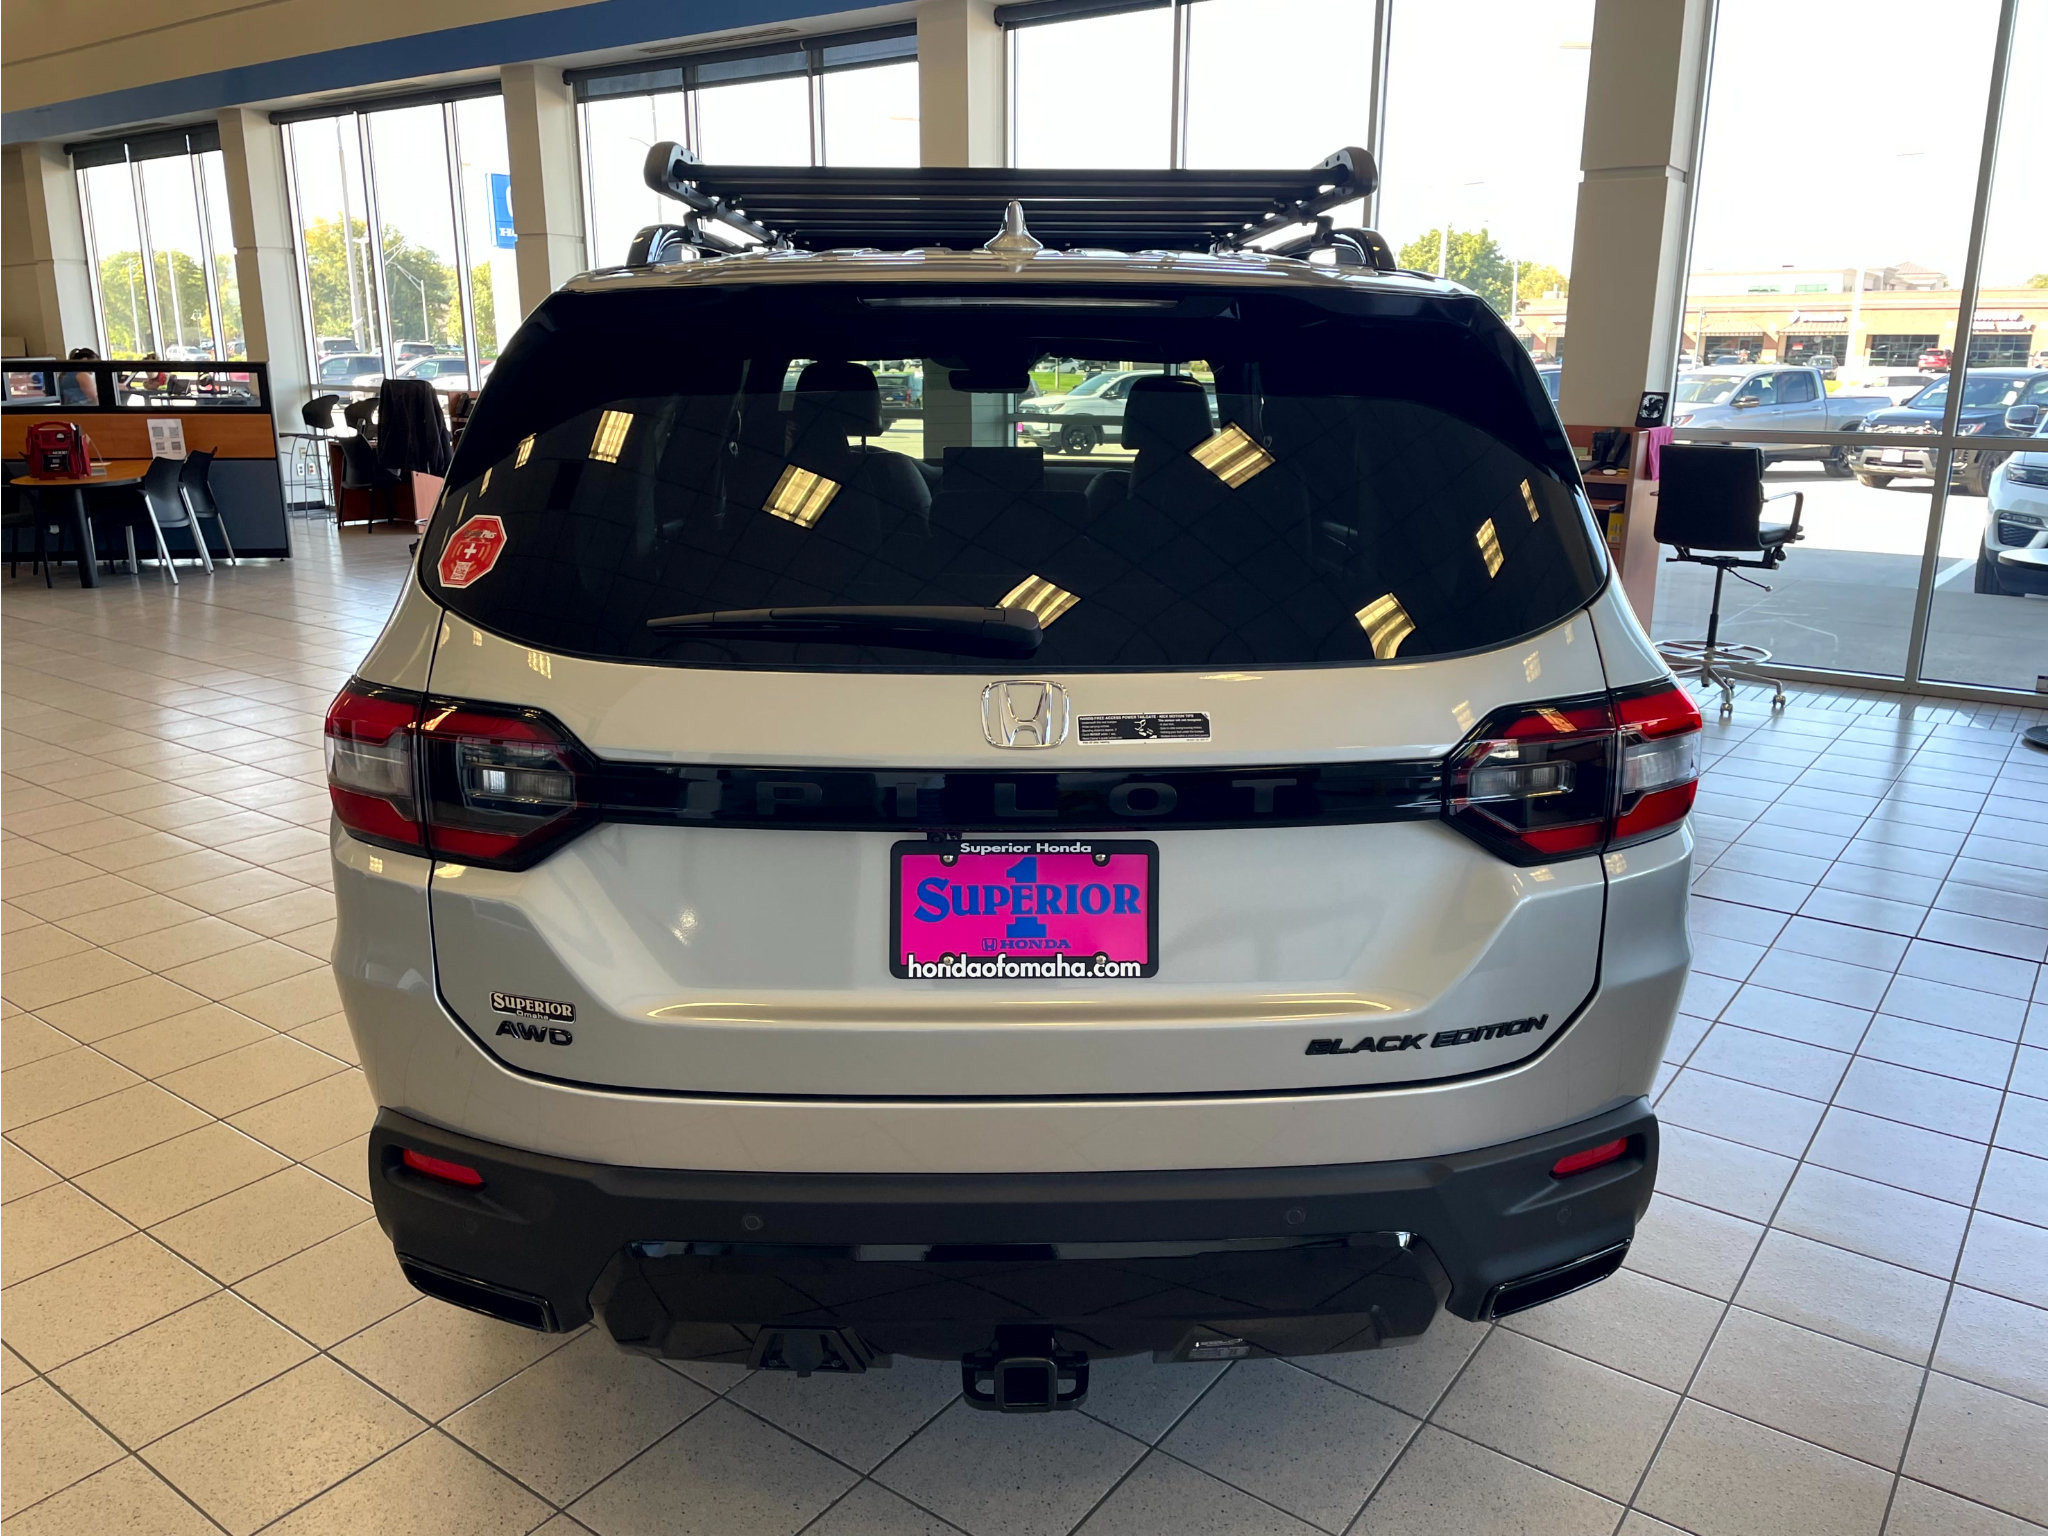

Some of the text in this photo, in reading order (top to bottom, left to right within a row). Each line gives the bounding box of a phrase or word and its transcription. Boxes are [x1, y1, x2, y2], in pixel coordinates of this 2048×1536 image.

[756, 778, 1297, 817] PILOT
[960, 842, 1092, 855] Superior Honda
[913, 877, 1141, 923] SUPERIOR
[999, 938, 1072, 950] HONDA
[908, 954, 1141, 979] hondaofomaha.com
[493, 992, 573, 1017] SUPERIOR
[495, 1020, 573, 1046] AWD
[1305, 1014, 1549, 1055] BLACK EDITION
